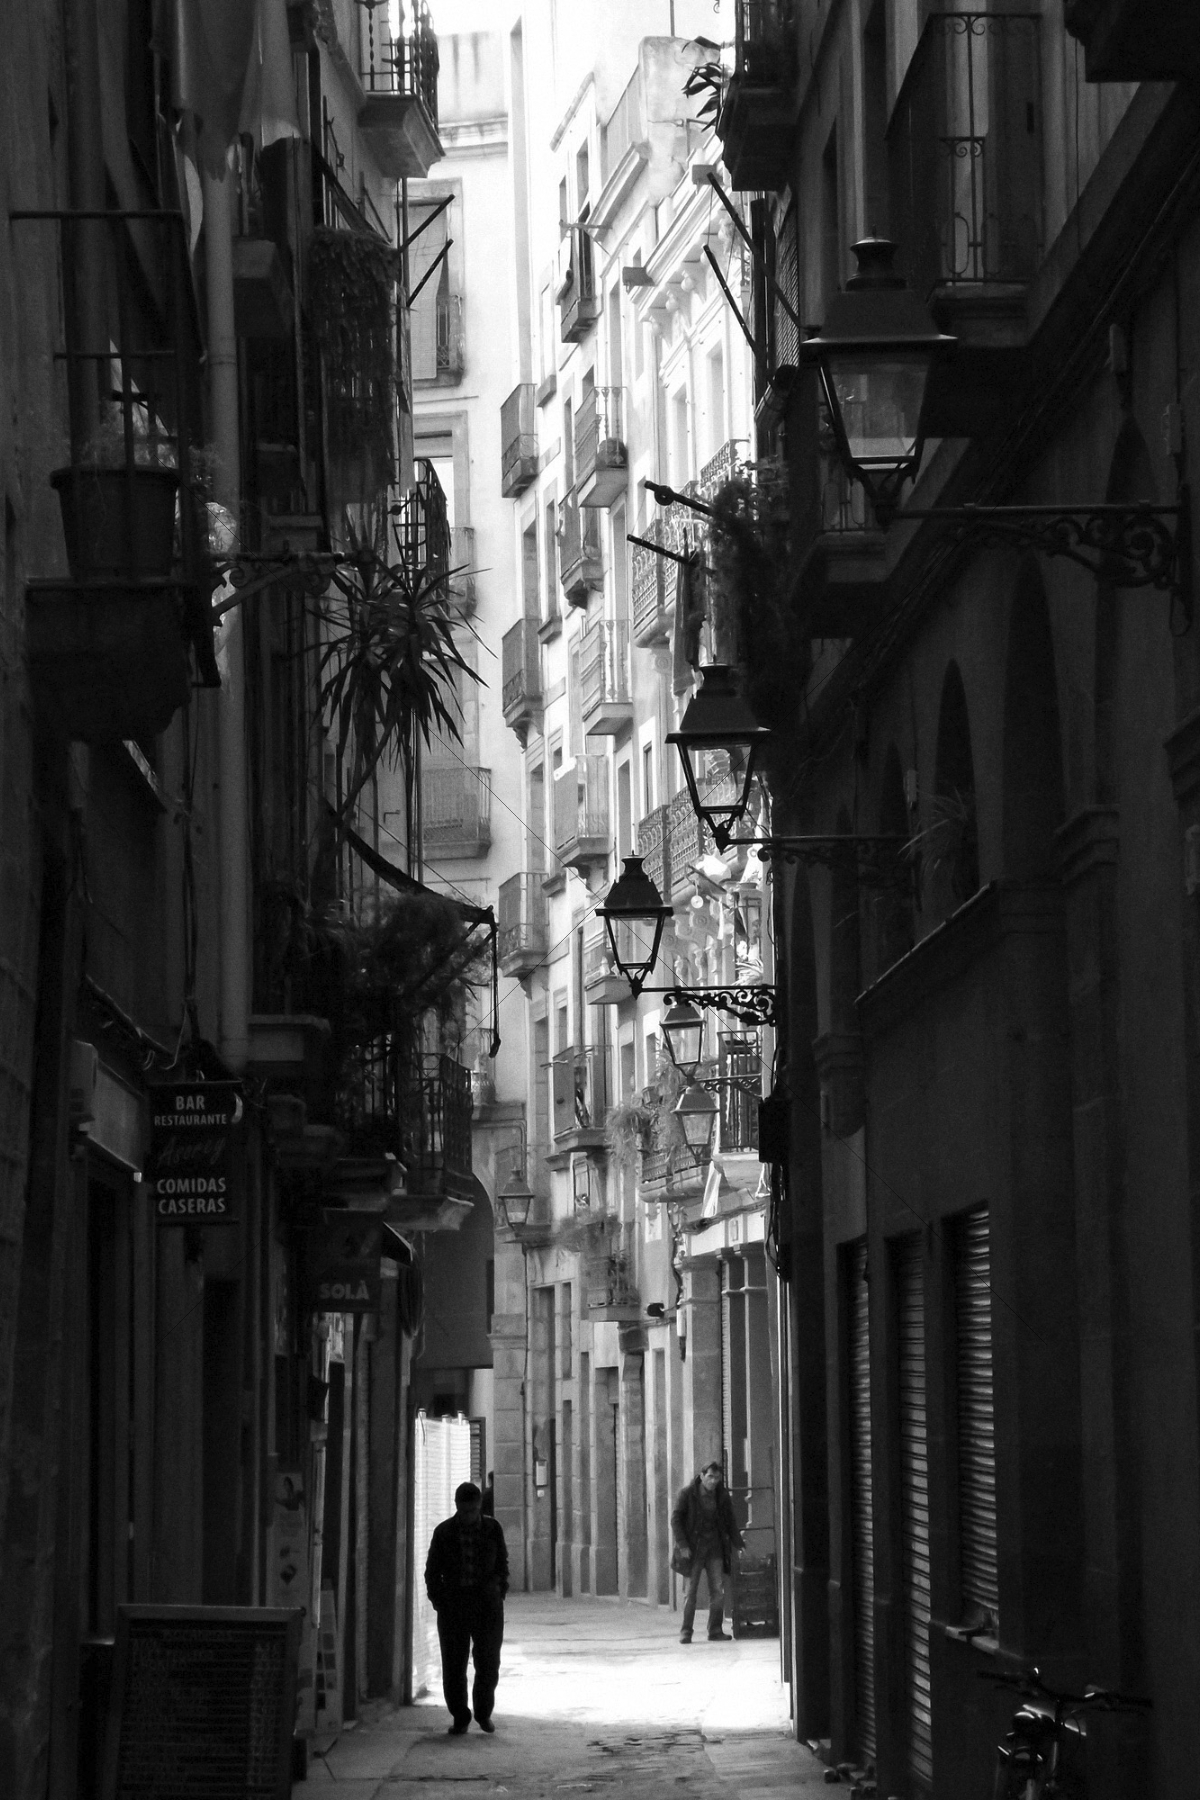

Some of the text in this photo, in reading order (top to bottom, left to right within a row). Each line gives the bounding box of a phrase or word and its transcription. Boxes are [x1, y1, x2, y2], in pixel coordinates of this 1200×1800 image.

[175, 1095, 205, 1110] BAR
[154, 1113, 227, 1126] RESTAURANTE
[157, 1177, 226, 1194] COMIDAS
[158, 1197, 226, 1215] CASERAS
